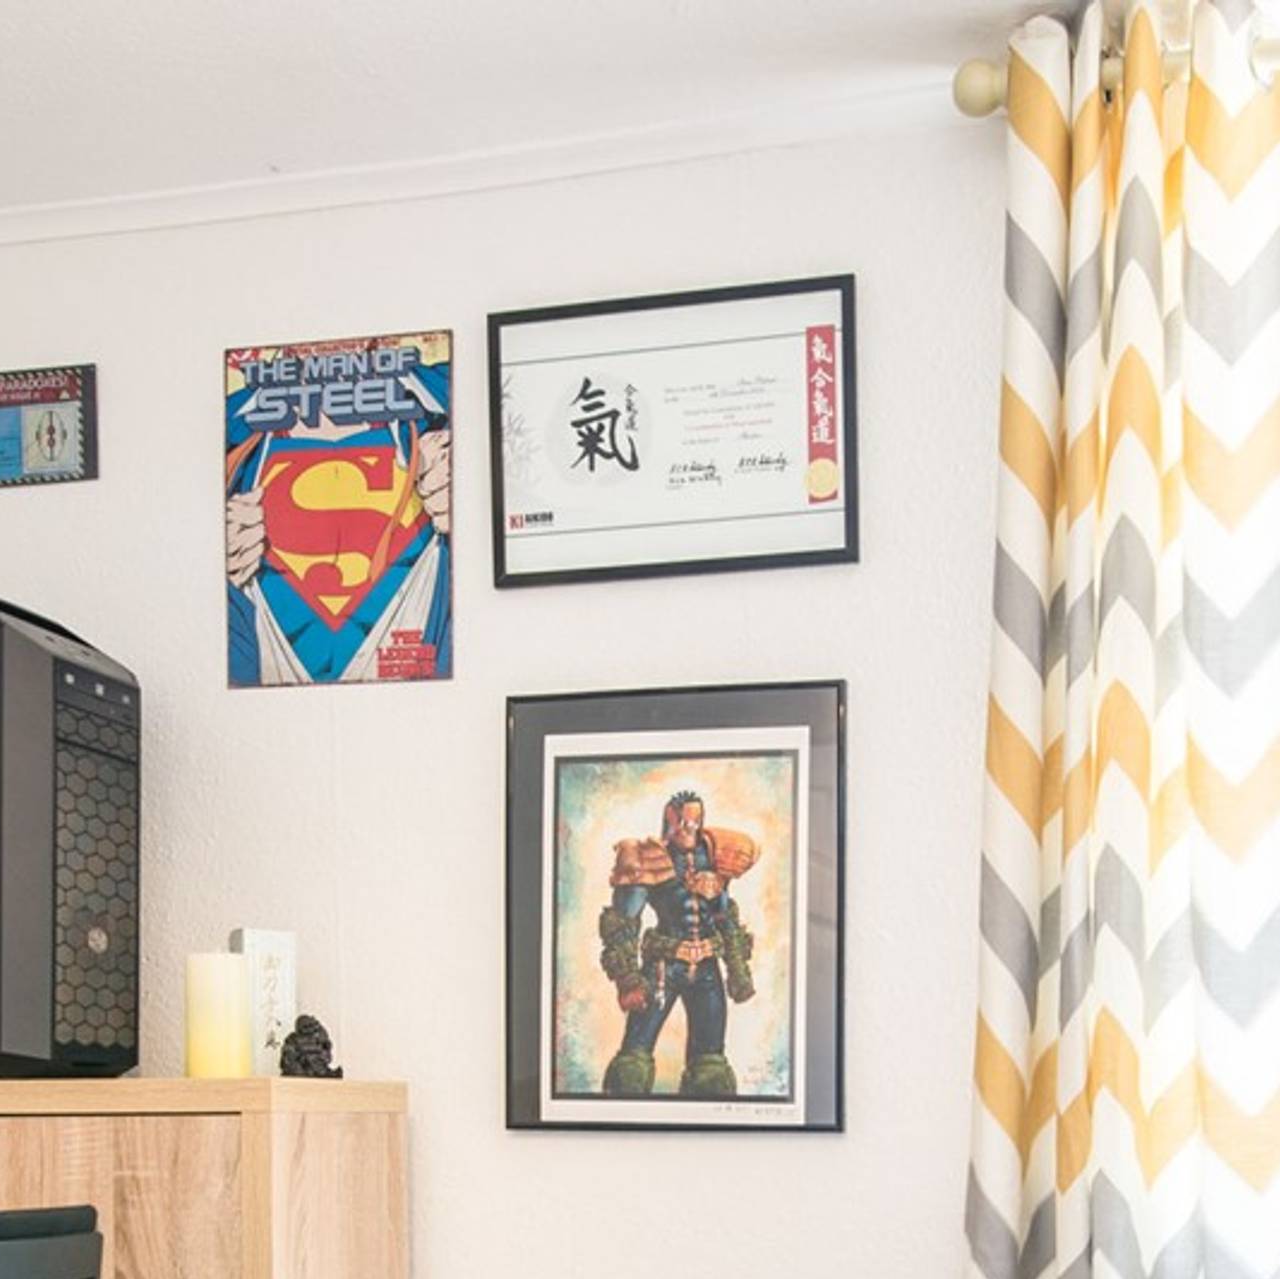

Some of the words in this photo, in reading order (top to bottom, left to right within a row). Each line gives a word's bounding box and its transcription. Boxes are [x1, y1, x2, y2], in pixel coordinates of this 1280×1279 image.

[240, 359, 297, 383] THE
[304, 352, 368, 378] MAN
[375, 346, 417, 373] OF
[244, 378, 416, 424] STEEL
